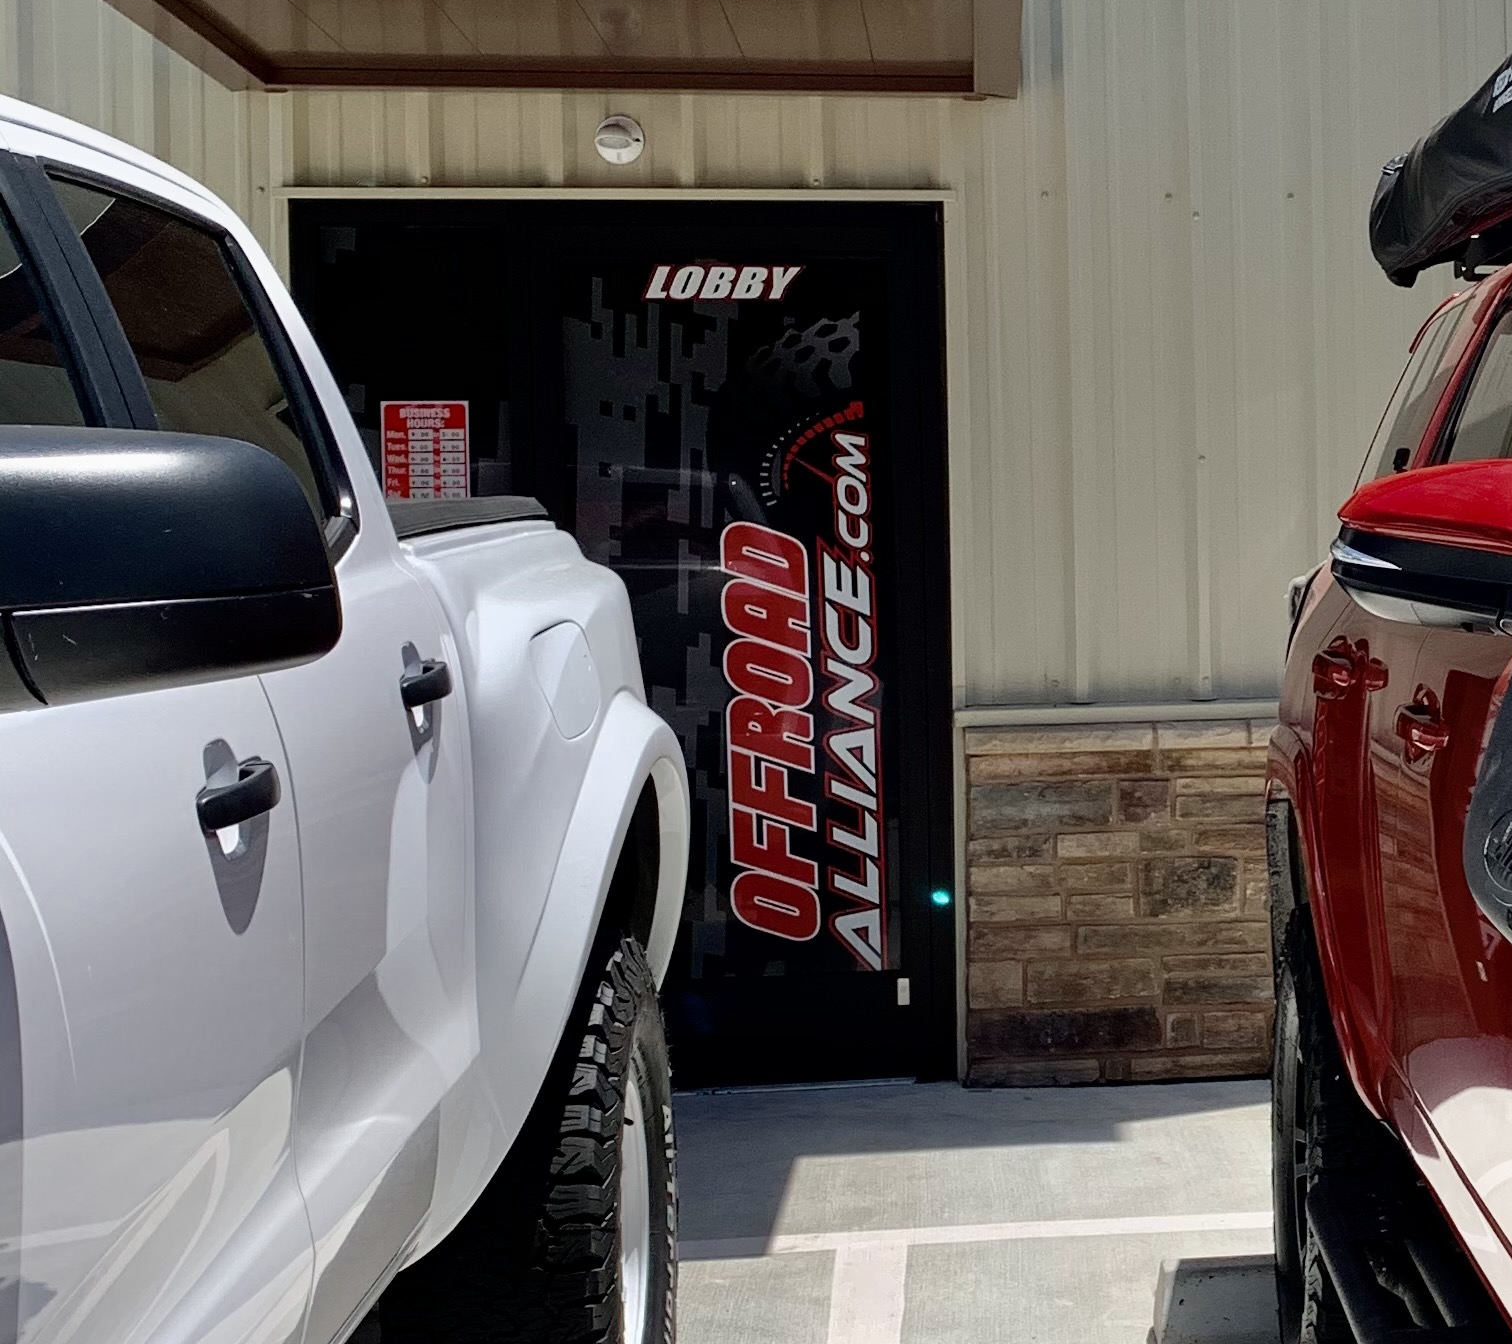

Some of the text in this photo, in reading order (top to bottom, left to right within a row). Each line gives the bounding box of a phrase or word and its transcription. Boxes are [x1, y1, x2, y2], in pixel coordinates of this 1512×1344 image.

[645, 266, 802, 300] LOBBY
[720, 521, 821, 941] OFFROAD
[829, 432, 883, 968] ALLIANCE.COM
